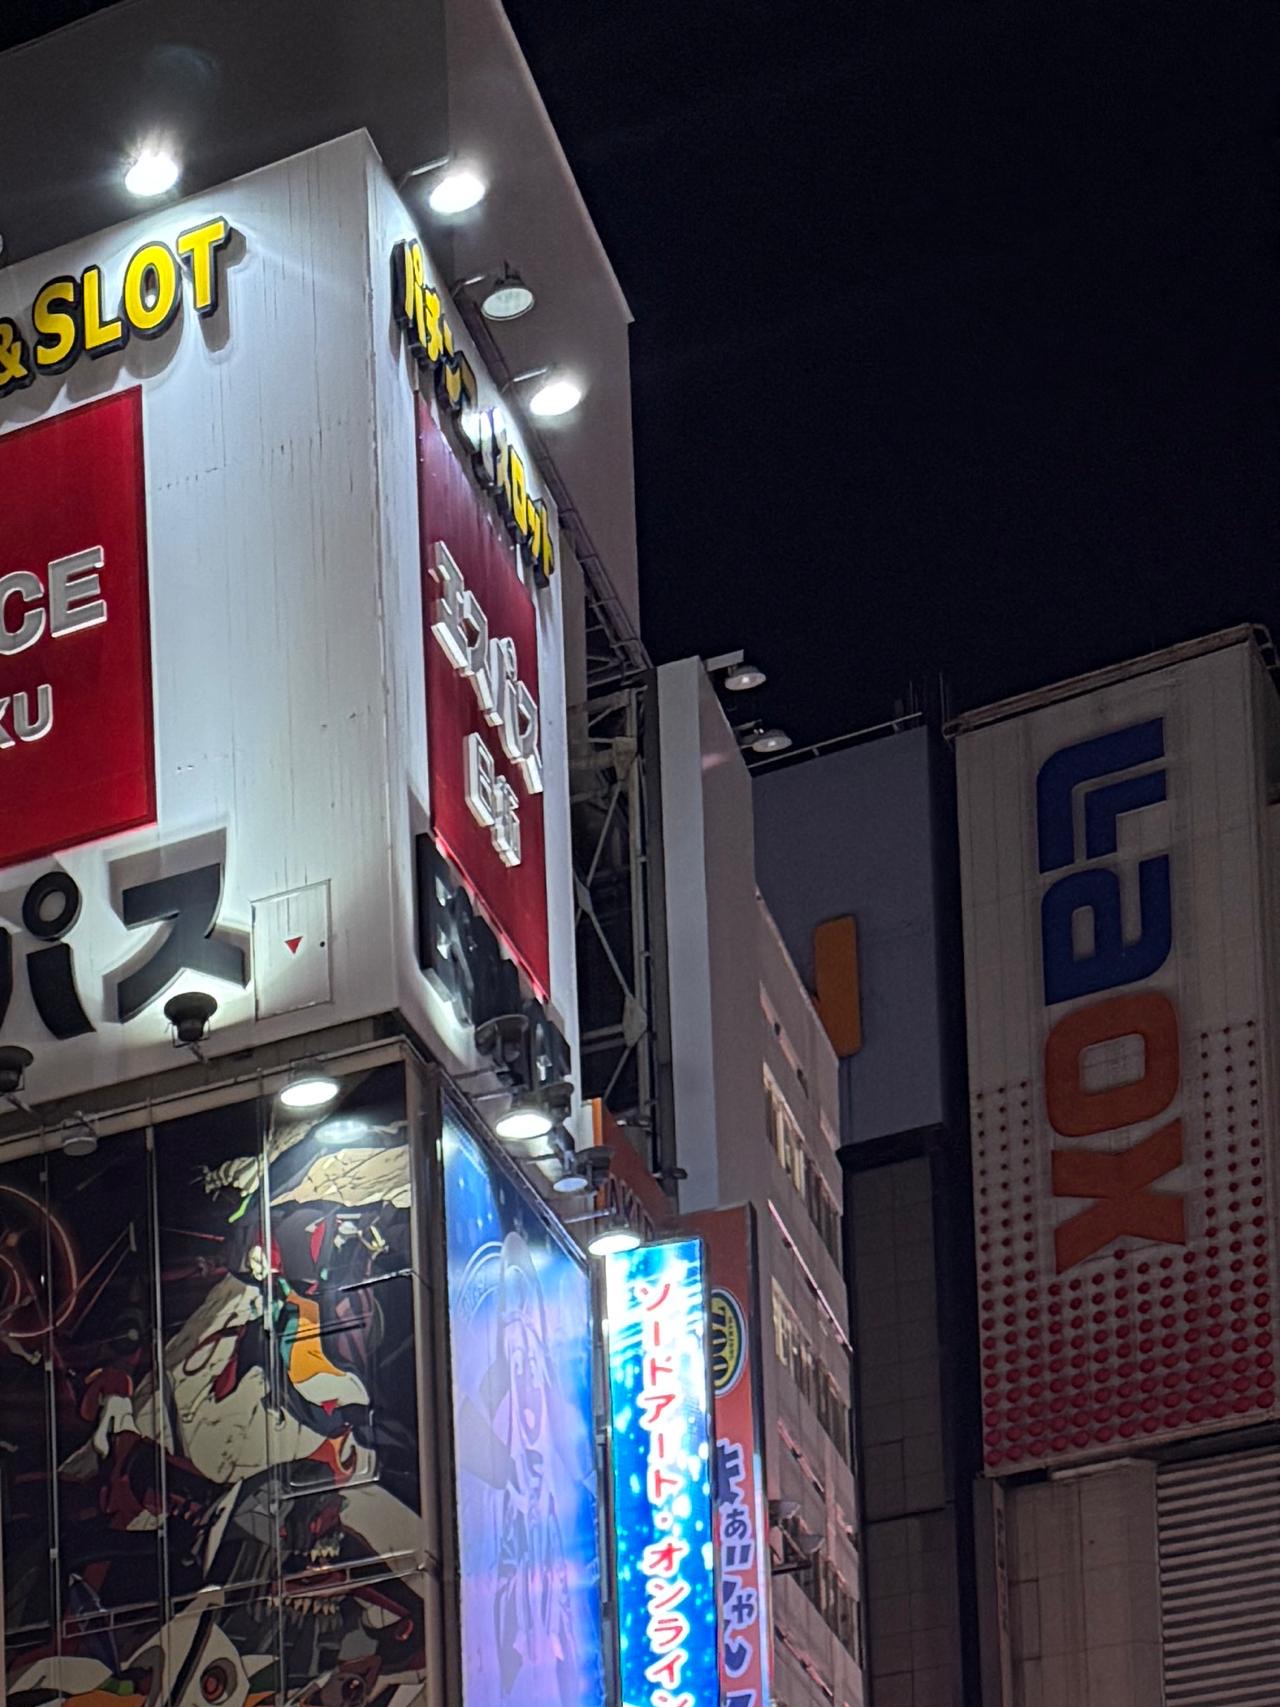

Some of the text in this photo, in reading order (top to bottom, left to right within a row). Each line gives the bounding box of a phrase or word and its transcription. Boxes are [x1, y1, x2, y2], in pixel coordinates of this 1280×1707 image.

[34, 215, 238, 376] SLOT
[428, 539, 544, 796] エスパス
